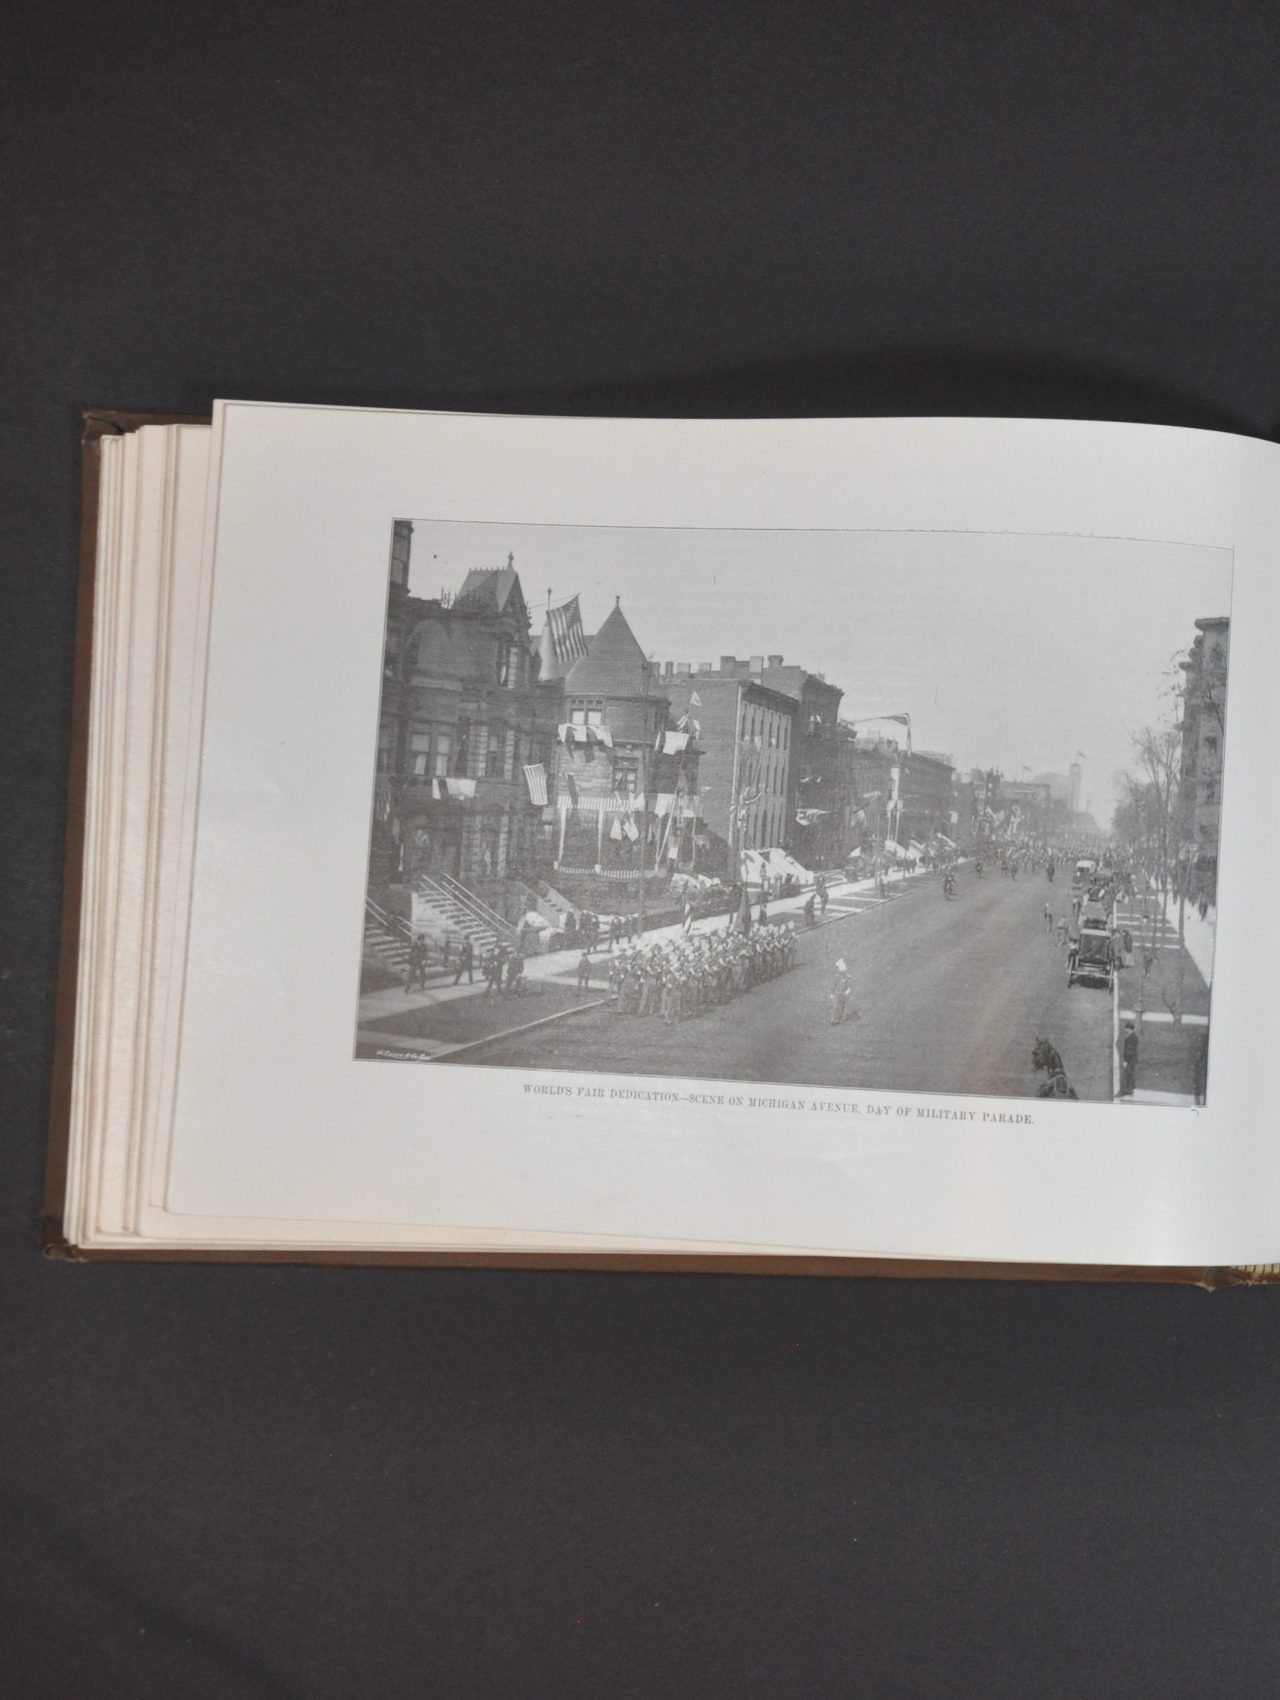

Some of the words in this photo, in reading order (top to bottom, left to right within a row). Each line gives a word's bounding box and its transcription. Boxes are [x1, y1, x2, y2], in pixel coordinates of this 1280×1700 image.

[523, 1084, 573, 1096] WORLD'S
[577, 1087, 605, 1098] FAIR
[728, 1096, 744, 1106] ON
[748, 1097, 805, 1110] MICHIGAN
[811, 1102, 861, 1115] AVENUE,
[866, 1105, 891, 1116] DAY
[896, 1107, 912, 1117] OF
[917, 1108, 976, 1121] MILITARY
[982, 1112, 1035, 1125] PARADE.
